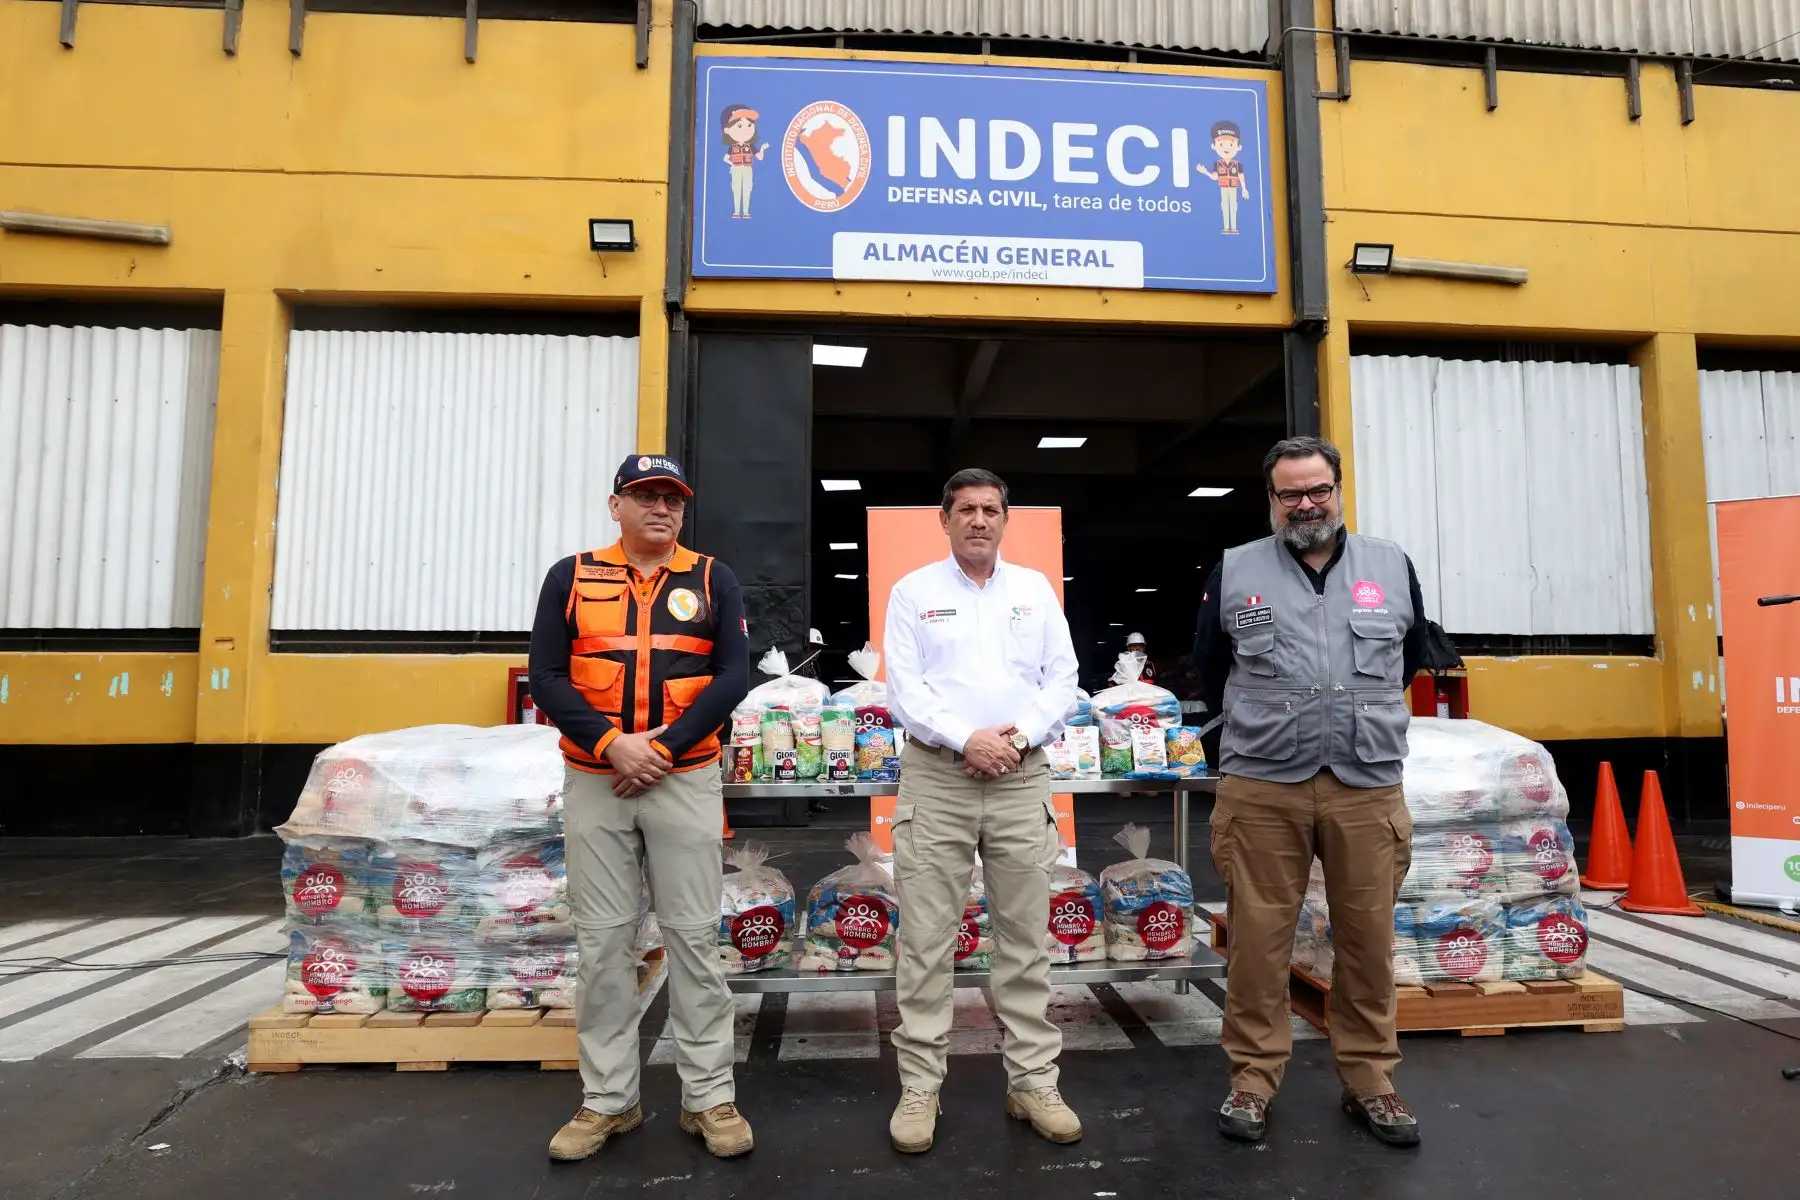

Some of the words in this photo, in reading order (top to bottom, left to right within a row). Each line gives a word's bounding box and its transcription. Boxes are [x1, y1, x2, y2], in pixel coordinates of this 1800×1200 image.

[784, 131, 797, 178] INSTITUTO
[795, 104, 834, 132] NACIONAL
[857, 158, 869, 178] CIVIL
[888, 115, 1189, 188] INDECI
[888, 186, 983, 206] DEFENSA
[988, 189, 1047, 211] CIVIL,
[1053, 193, 1103, 210] tarea
[1109, 193, 1132, 211] de
[1136, 194, 1192, 213] todos
[863, 240, 988, 264] ALMACÉN
[996, 246, 1114, 268] GENERAL
[932, 267, 1048, 281] www.gob.pe/indeci
[652, 457, 679, 472] INDECI
[843, 930, 878, 940] HOMBRO
[844, 925, 872, 933] HOMBRO
[742, 935, 769, 943] HOMBRO
[742, 939, 774, 949] HOMBRO
[1146, 933, 1176, 942] HOMBRO
